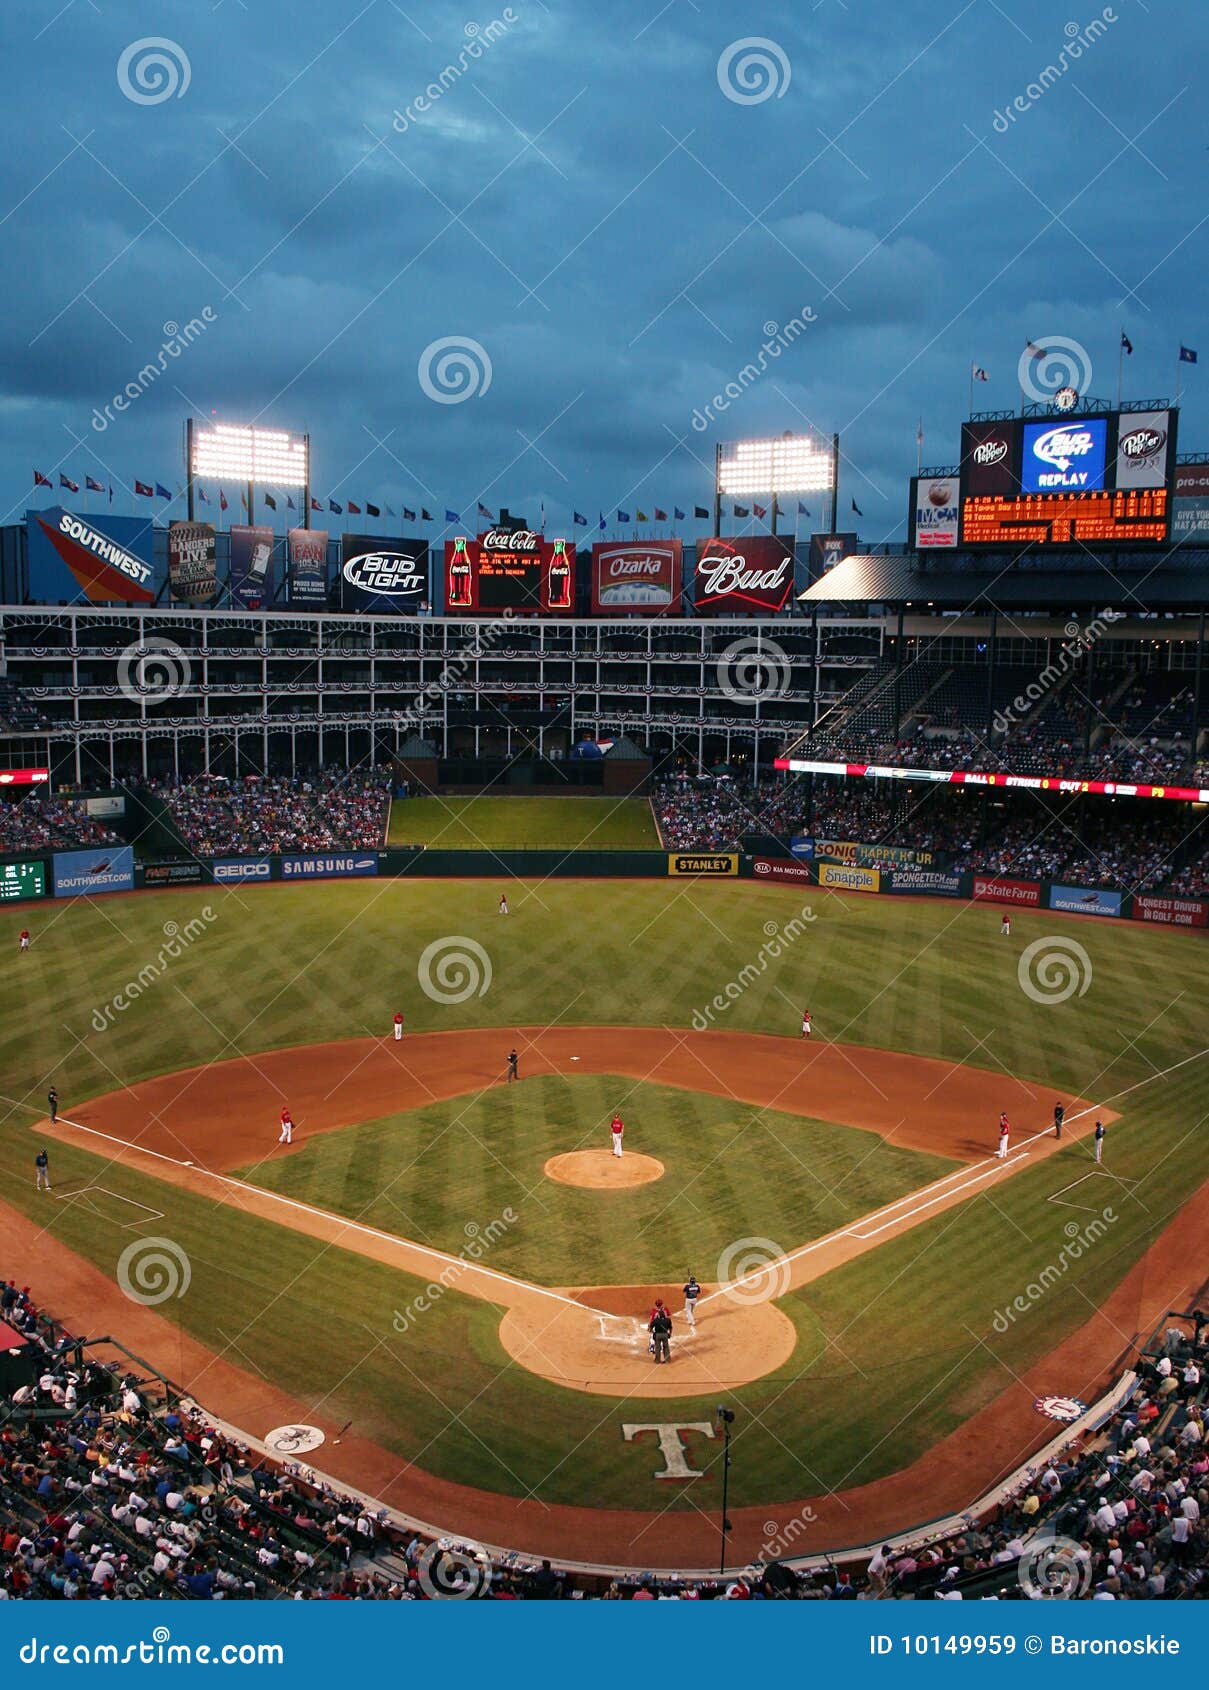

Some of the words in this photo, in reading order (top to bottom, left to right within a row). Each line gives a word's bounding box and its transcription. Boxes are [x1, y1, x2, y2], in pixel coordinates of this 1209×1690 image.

[1050, 433, 1092, 447] BUD
[1127, 436, 1159, 455] Pepper
[1136, 432, 1151, 445] Dr
[977, 445, 1004, 464] Pepper
[986, 442, 997, 452] Dr
[1038, 472, 1088, 487] REPLAY
[170, 538, 215, 553] RANGERS
[483, 530, 537, 550] Coca-Cola
[825, 540, 841, 550] FOX
[59, 514, 151, 583] SOUTHWEST
[180, 548, 208, 563] LIVE
[294, 543, 323, 560] FAN
[362, 556, 416, 574] BUD
[826, 551, 838, 565] 4
[610, 556, 662, 577] Ozarka
[352, 570, 425, 588] LIGHT
[698, 555, 791, 595] Bud
[964, 774, 988, 784] BALL
[988, 775, 996, 785] 0
[1005, 776, 1042, 788] STRIKE
[1042, 779, 1049, 789] 0
[1059, 780, 1082, 790] OUT
[1081, 782, 1089, 792] 2
[815, 843, 857, 859] SONIC
[861, 847, 897, 861] HAPPY
[214, 863, 270, 877] GEICO
[284, 858, 354, 874] SAMSUNG
[679, 860, 728, 870] STANLEY
[773, 866, 784, 874] KIA
[783, 867, 809, 877] MOTORS
[57, 873, 131, 888] SOUTHWEST.COM
[825, 868, 873, 889] Snapple
[1138, 896, 1173, 909] LONGEST
[1173, 900, 1202, 913] DRIVER
[622, 1421, 716, 1479] T
